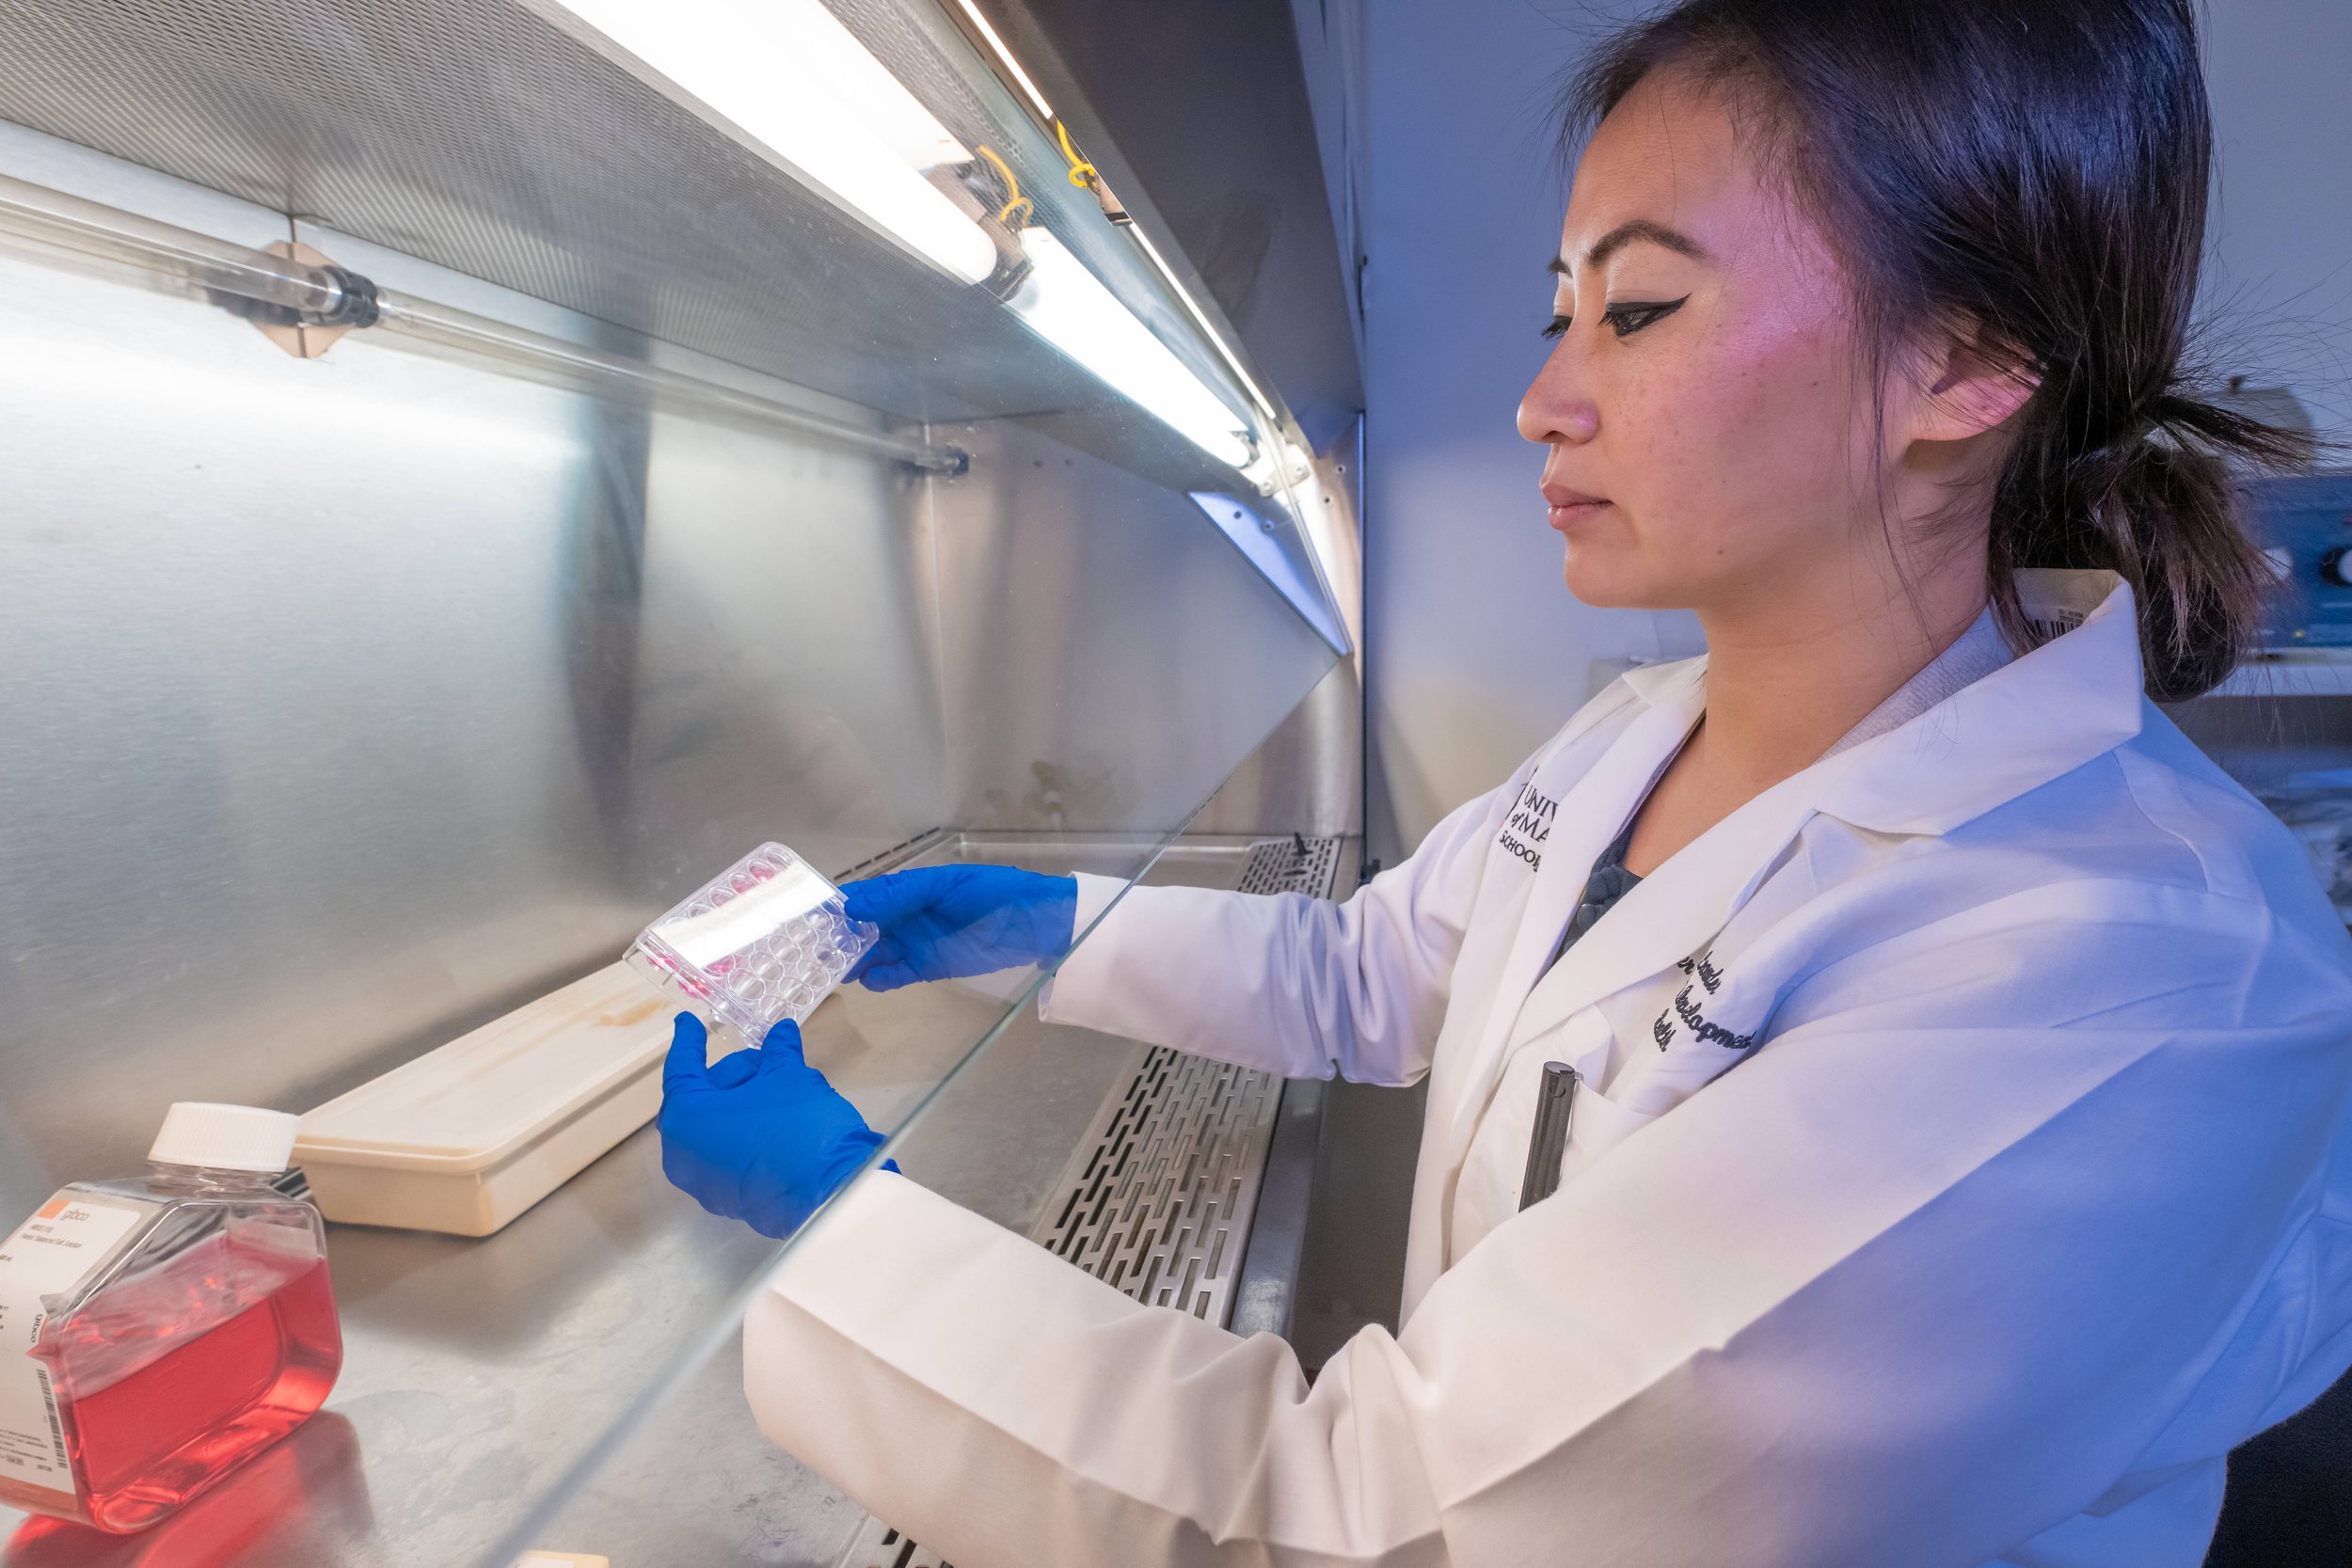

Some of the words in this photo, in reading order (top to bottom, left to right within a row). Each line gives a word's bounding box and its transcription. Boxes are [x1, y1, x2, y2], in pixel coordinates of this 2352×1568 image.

[1512, 812, 1525, 828] of
[60, 1208, 90, 1222] gibco
[30, 1313, 43, 1343] gibco
